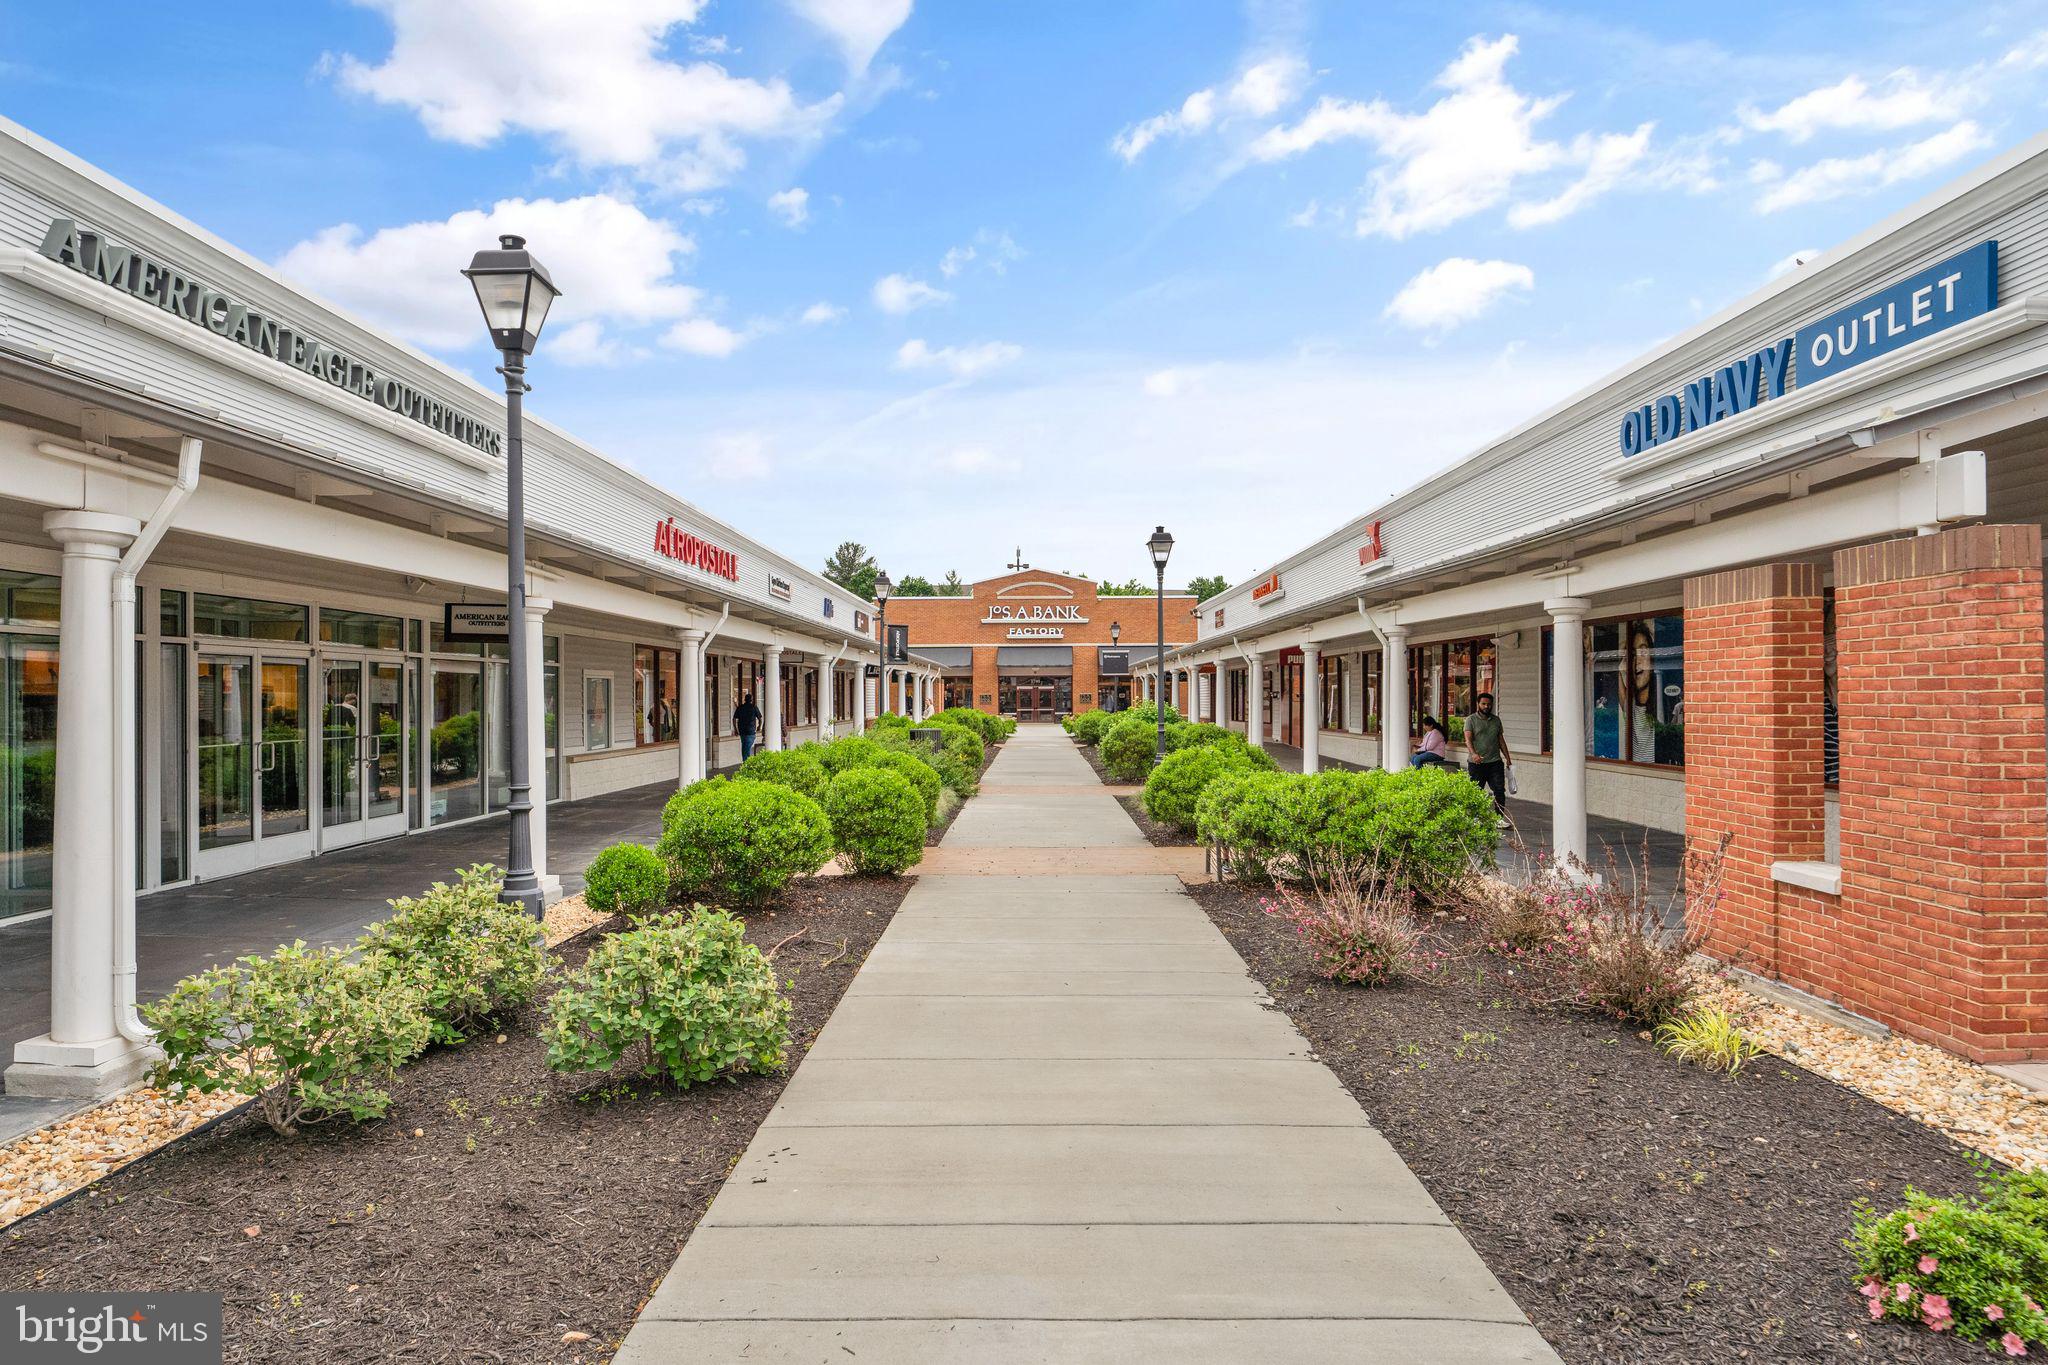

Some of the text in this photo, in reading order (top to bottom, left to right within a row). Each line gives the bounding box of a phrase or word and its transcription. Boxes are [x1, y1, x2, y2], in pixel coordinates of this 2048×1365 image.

[38, 218, 502, 457] AMERICAN EAGLE OUTFITTERS
[1810, 271, 1963, 368] OUTLET
[1620, 338, 1794, 458] OLD NAVY
[1009, 627, 1064, 635] FACTORY
[1033, 605, 1083, 619] BANK
